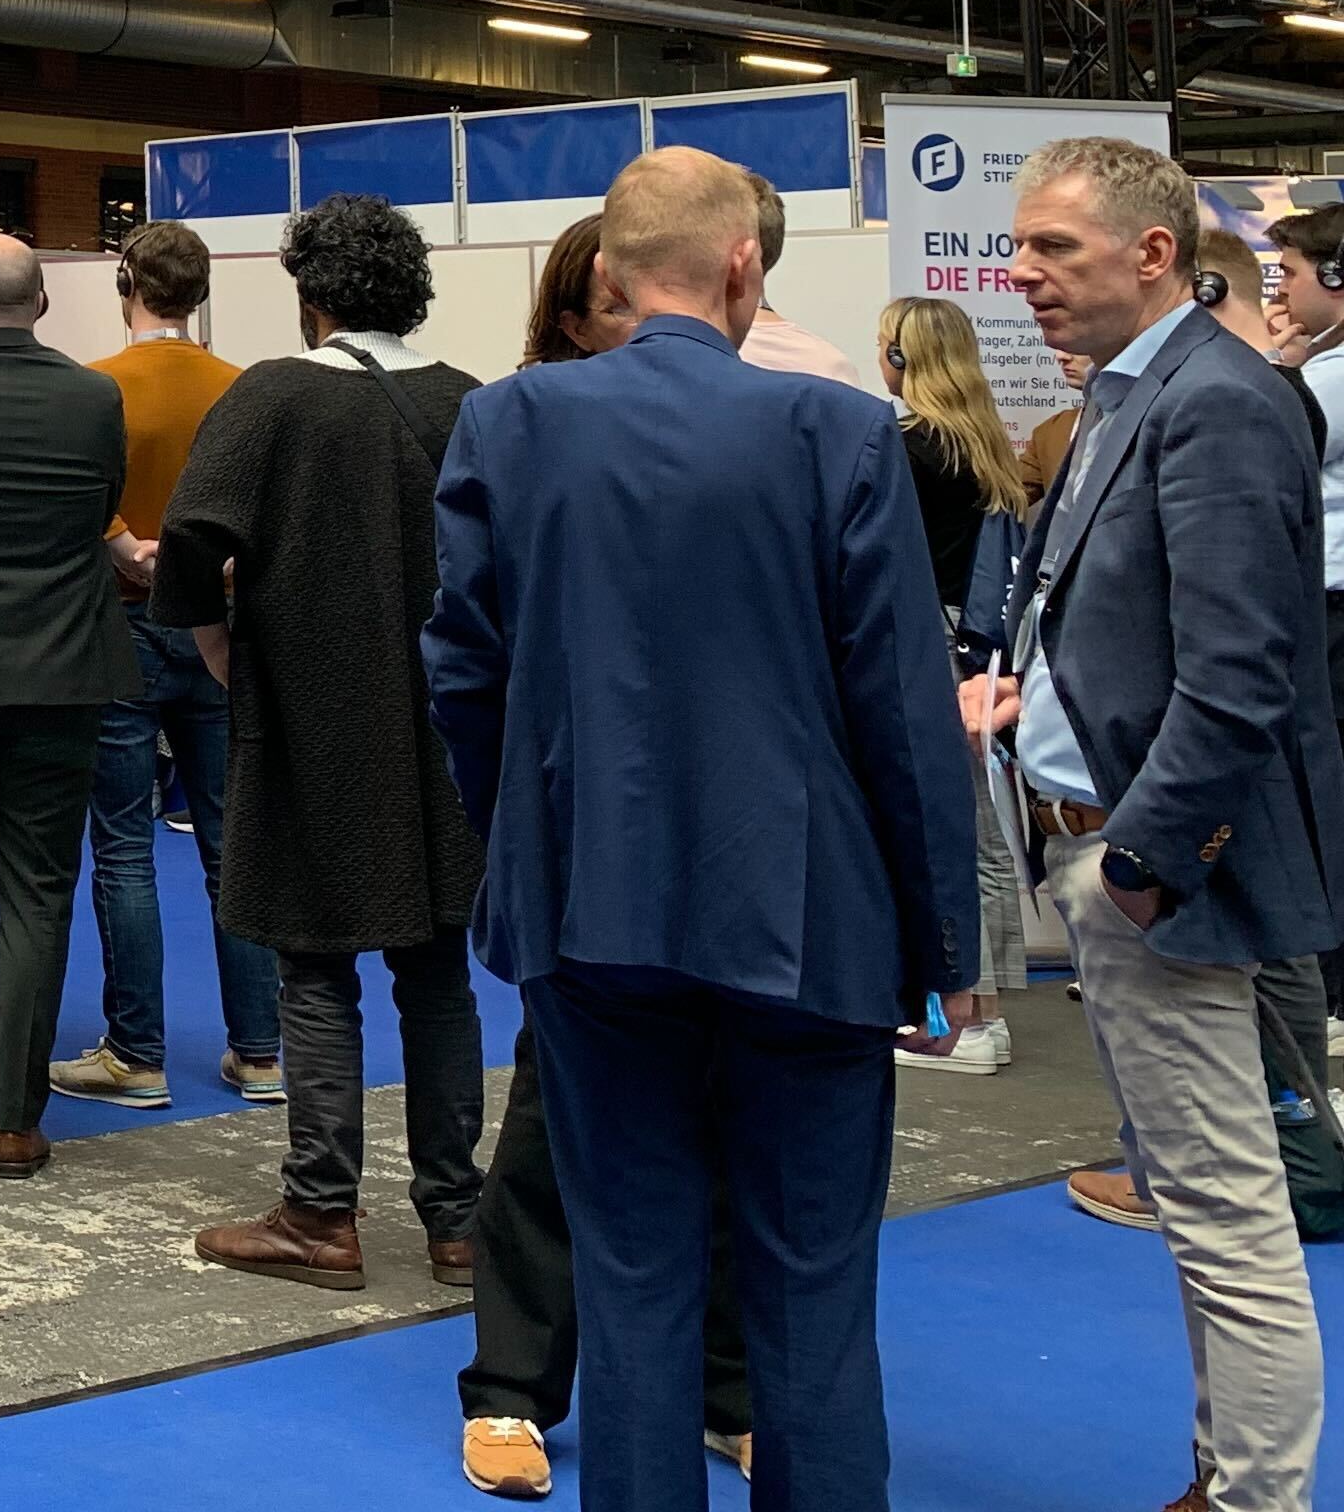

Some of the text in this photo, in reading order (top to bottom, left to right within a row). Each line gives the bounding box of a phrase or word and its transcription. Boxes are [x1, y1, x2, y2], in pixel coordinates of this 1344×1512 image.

[924, 232, 1014, 258] EIN JO
[926, 266, 969, 292] DIE
[976, 316, 1041, 329] Kommunik
[977, 335, 1044, 349] nager, Zahl
[981, 353, 1032, 367] ulsgeber
[1010, 377, 1027, 389] wir
[1031, 377, 1050, 390] Sie
